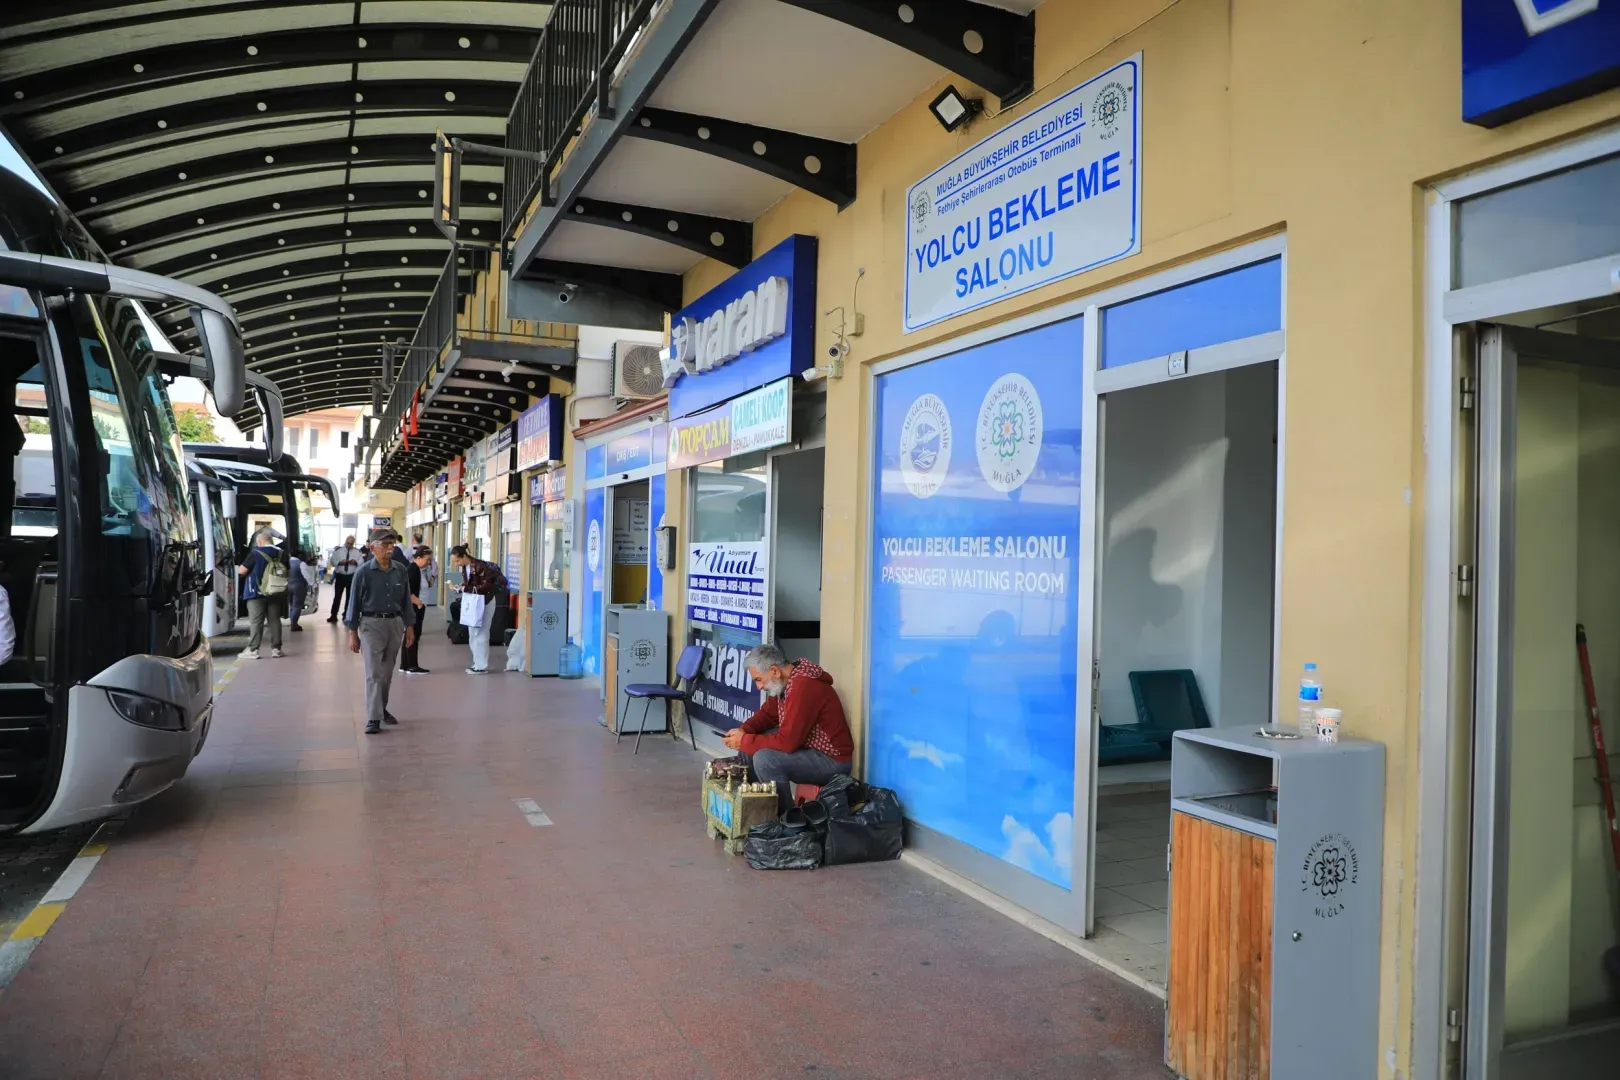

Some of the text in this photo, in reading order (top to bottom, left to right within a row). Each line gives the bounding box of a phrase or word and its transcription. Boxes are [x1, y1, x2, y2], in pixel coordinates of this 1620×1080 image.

[936, 102, 1083, 197] MUĞLA BÜYÜKŞEHİR BELEDİYESİ
[937, 196, 960, 217] Fethiye
[961, 173, 1006, 206] Şehirlerarası
[1007, 156, 1038, 179] Otobüs
[1039, 132, 1082, 164] Terminali
[915, 151, 1121, 274] YOLCU BEKLEME
[955, 231, 1054, 299] SALONU
[695, 275, 789, 372] varan
[762, 388, 786, 423] KOOP.
[680, 416, 730, 457] TOPÇAM
[992, 468, 1022, 484] MUĞLA
[704, 545, 758, 575] Ünal
[882, 535, 1067, 559] YOLCU BEKLEME SALONU
[881, 566, 1065, 594] PASSENGER WAITING ROOM
[695, 638, 752, 693] aran
